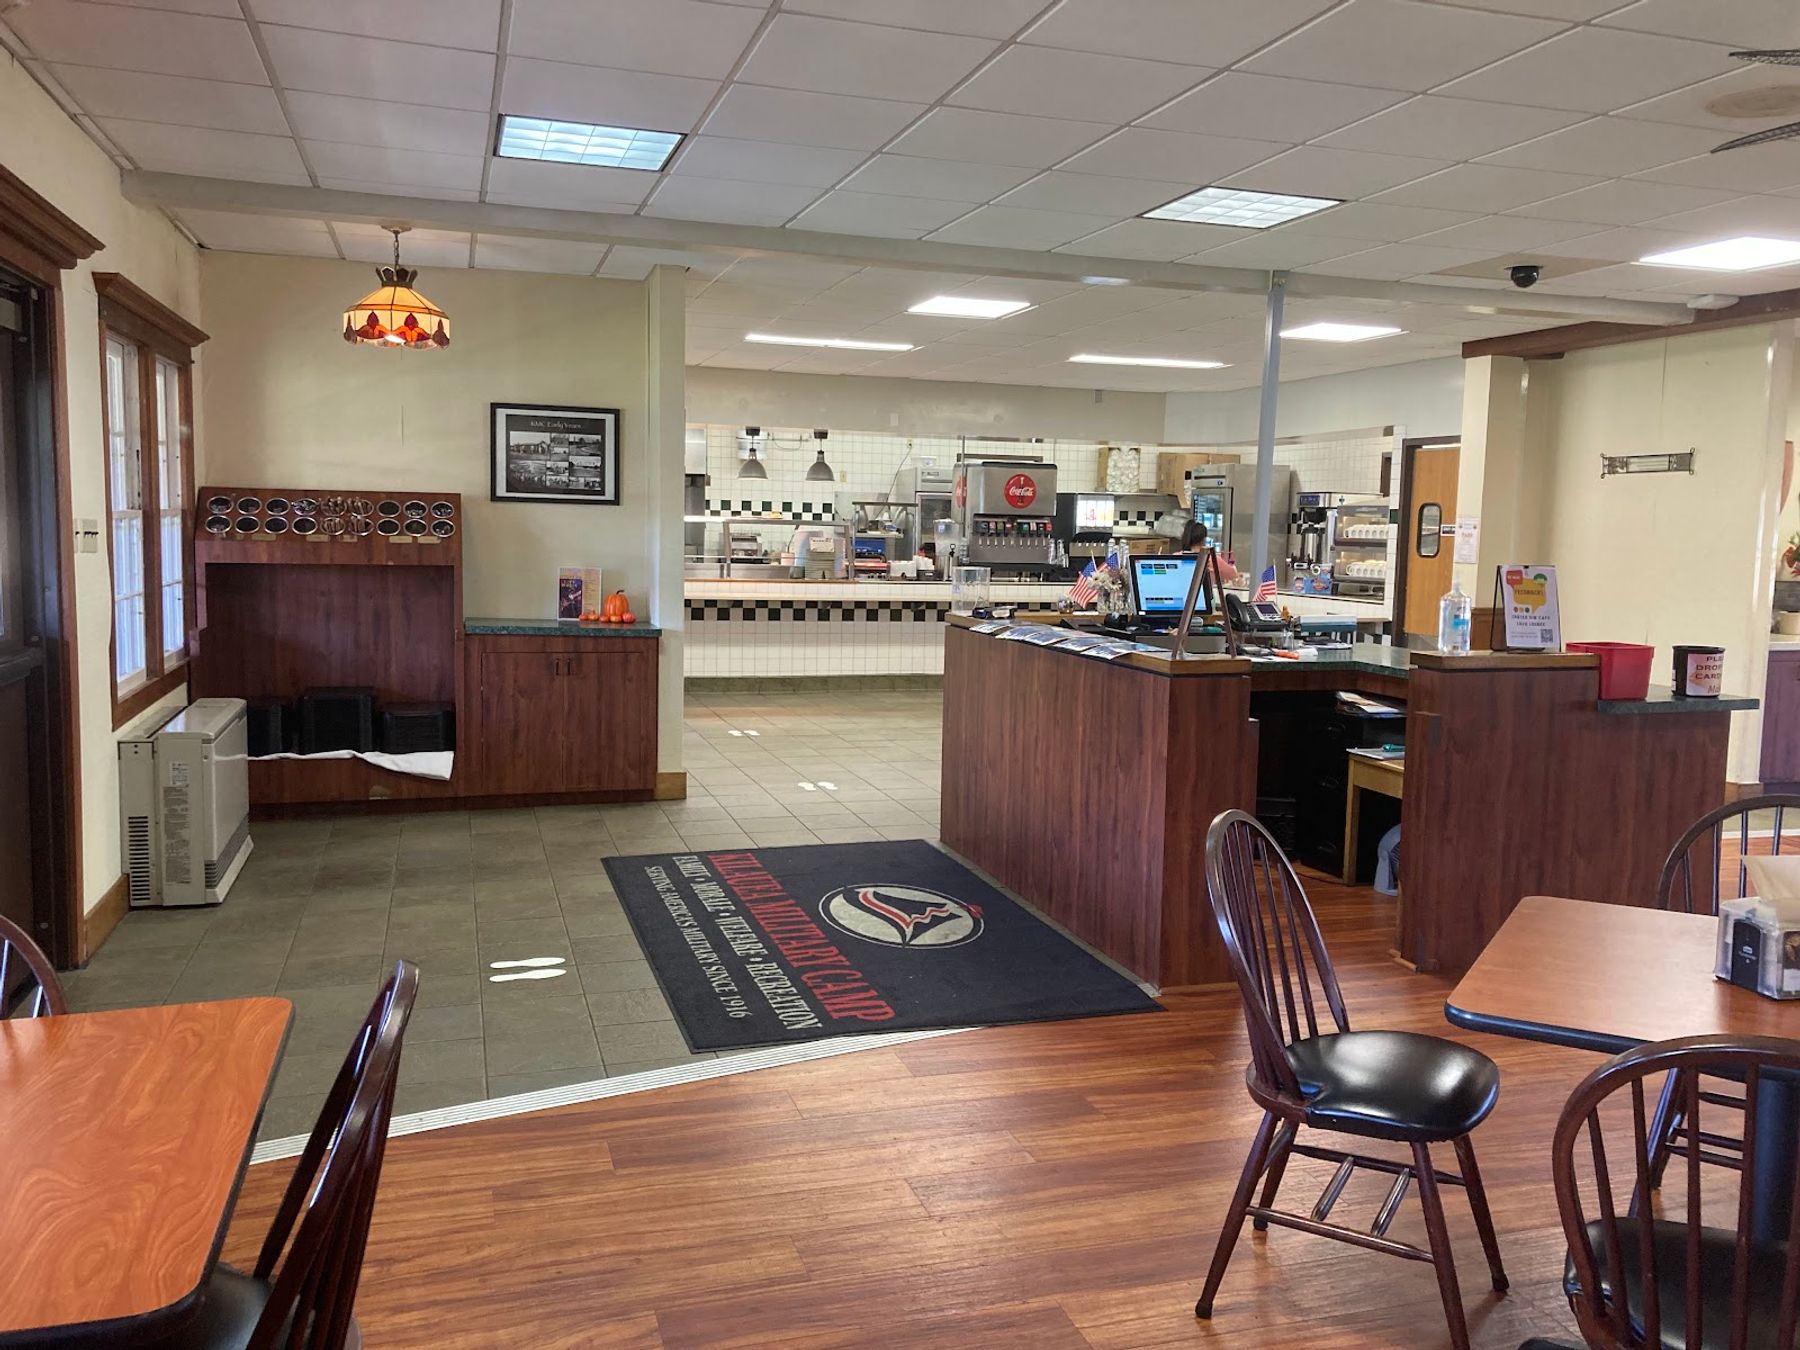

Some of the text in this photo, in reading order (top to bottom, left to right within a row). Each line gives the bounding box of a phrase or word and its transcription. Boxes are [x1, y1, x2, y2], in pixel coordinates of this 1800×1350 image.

[1009, 486, 1034, 497] Coca-Cola
[644, 865, 676, 891] SERVING
[680, 927, 721, 964] MILITARY
[702, 965, 738, 993] SINCE
[720, 995, 753, 1018] 1916
[672, 855, 823, 1030] FAMILY MORALE WELFARE RECREATION
[707, 852, 896, 1022] KILAUEA MILITARY CAMP
